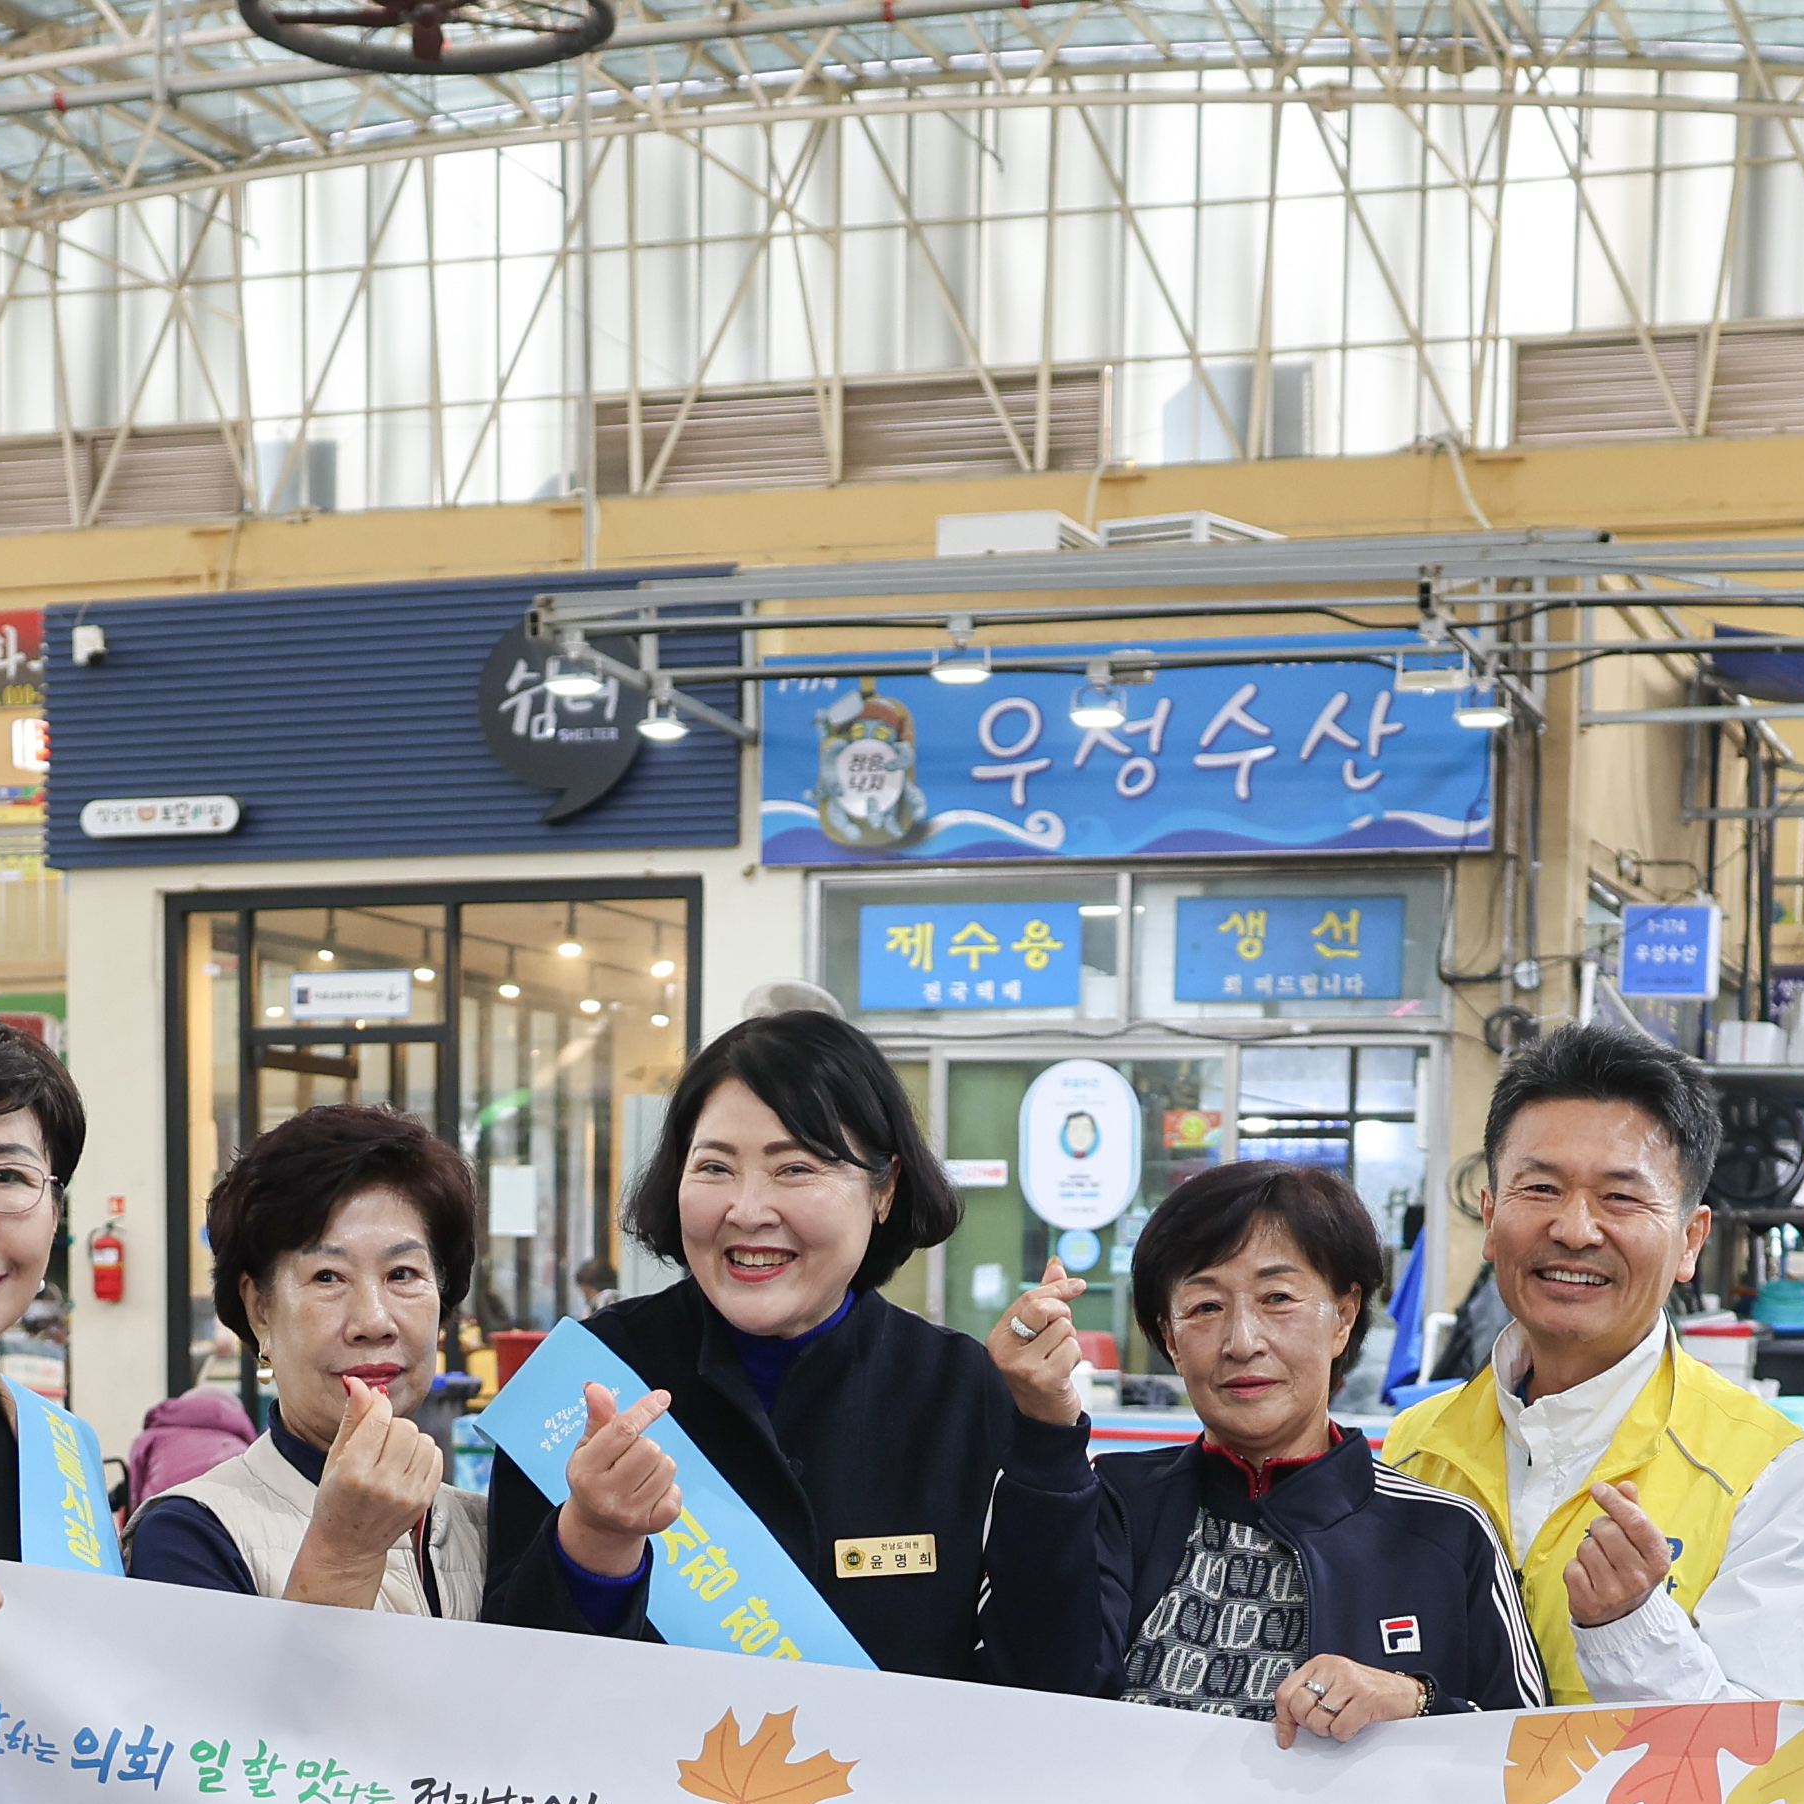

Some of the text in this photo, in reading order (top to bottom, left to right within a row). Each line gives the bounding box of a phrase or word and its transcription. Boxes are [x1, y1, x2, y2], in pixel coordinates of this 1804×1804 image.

[971, 683, 1407, 807] 우정수산
[885, 919, 1065, 972] 제수용
[870, 1551, 932, 1570] 윤명희
[69, 1724, 175, 1792] 의회
